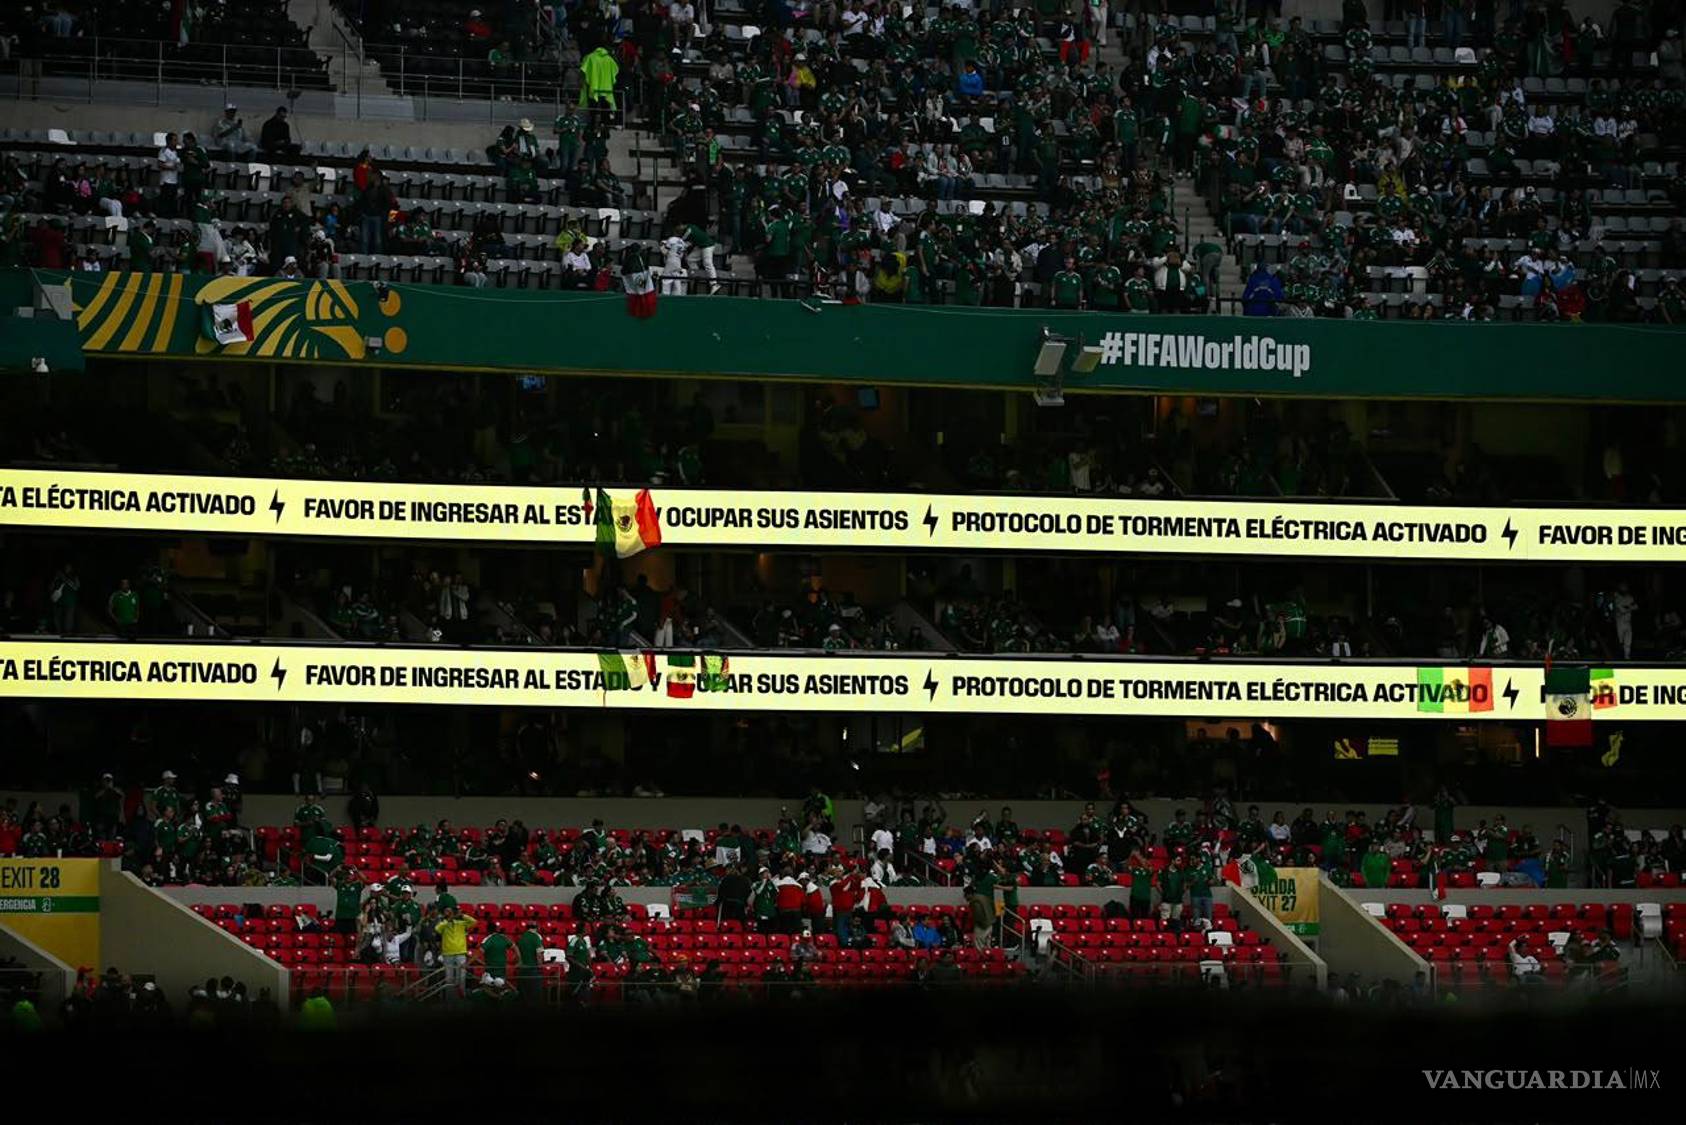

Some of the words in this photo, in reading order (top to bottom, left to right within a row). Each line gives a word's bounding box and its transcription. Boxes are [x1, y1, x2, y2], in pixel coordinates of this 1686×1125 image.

[1101, 332, 1311, 377] #FIFAWorldCup
[0, 485, 17, 507] A
[23, 484, 140, 512] ELÉCTRICA
[146, 491, 255, 515] ACTIVADO
[305, 498, 374, 520] FAVOR
[379, 501, 406, 521] DE
[411, 502, 518, 524] INGRESAR
[524, 505, 550, 525] AL
[667, 507, 752, 529] OCUPAR
[757, 508, 799, 529] SUS
[804, 509, 908, 532] ASIENTOS
[953, 512, 1081, 534] PROTOCOLO
[1087, 515, 1114, 535] DE
[1118, 516, 1241, 538] TORMENTA
[1246, 516, 1367, 541] ELÉCTRICA
[1372, 522, 1486, 543] ACTIVADO
[1540, 525, 1612, 546] FAVOR
[1619, 526, 1646, 546] DE
[0, 659, 18, 681] A
[24, 656, 142, 682] ELÉCTRICA
[147, 661, 257, 683] ACTIVADO
[306, 665, 375, 686] FAVOR
[381, 666, 407, 687] DE
[412, 667, 518, 689] INGRESAR
[524, 670, 550, 690] AL
[757, 674, 799, 695] SUS
[804, 675, 908, 696] ASIENTOS
[953, 676, 1082, 698] PROTOCOLO
[1088, 679, 1114, 699] DE
[1119, 680, 1241, 701] TORMENTA
[1247, 678, 1368, 702] ELÉCTRICA
[1373, 684, 1487, 703] ACTIVADO
[1620, 685, 1648, 705] DE
[2, 867, 36, 888] EXIT
[40, 867, 60, 888] 28
[1253, 896, 1277, 911] XIT
[1282, 896, 1296, 911] 27
